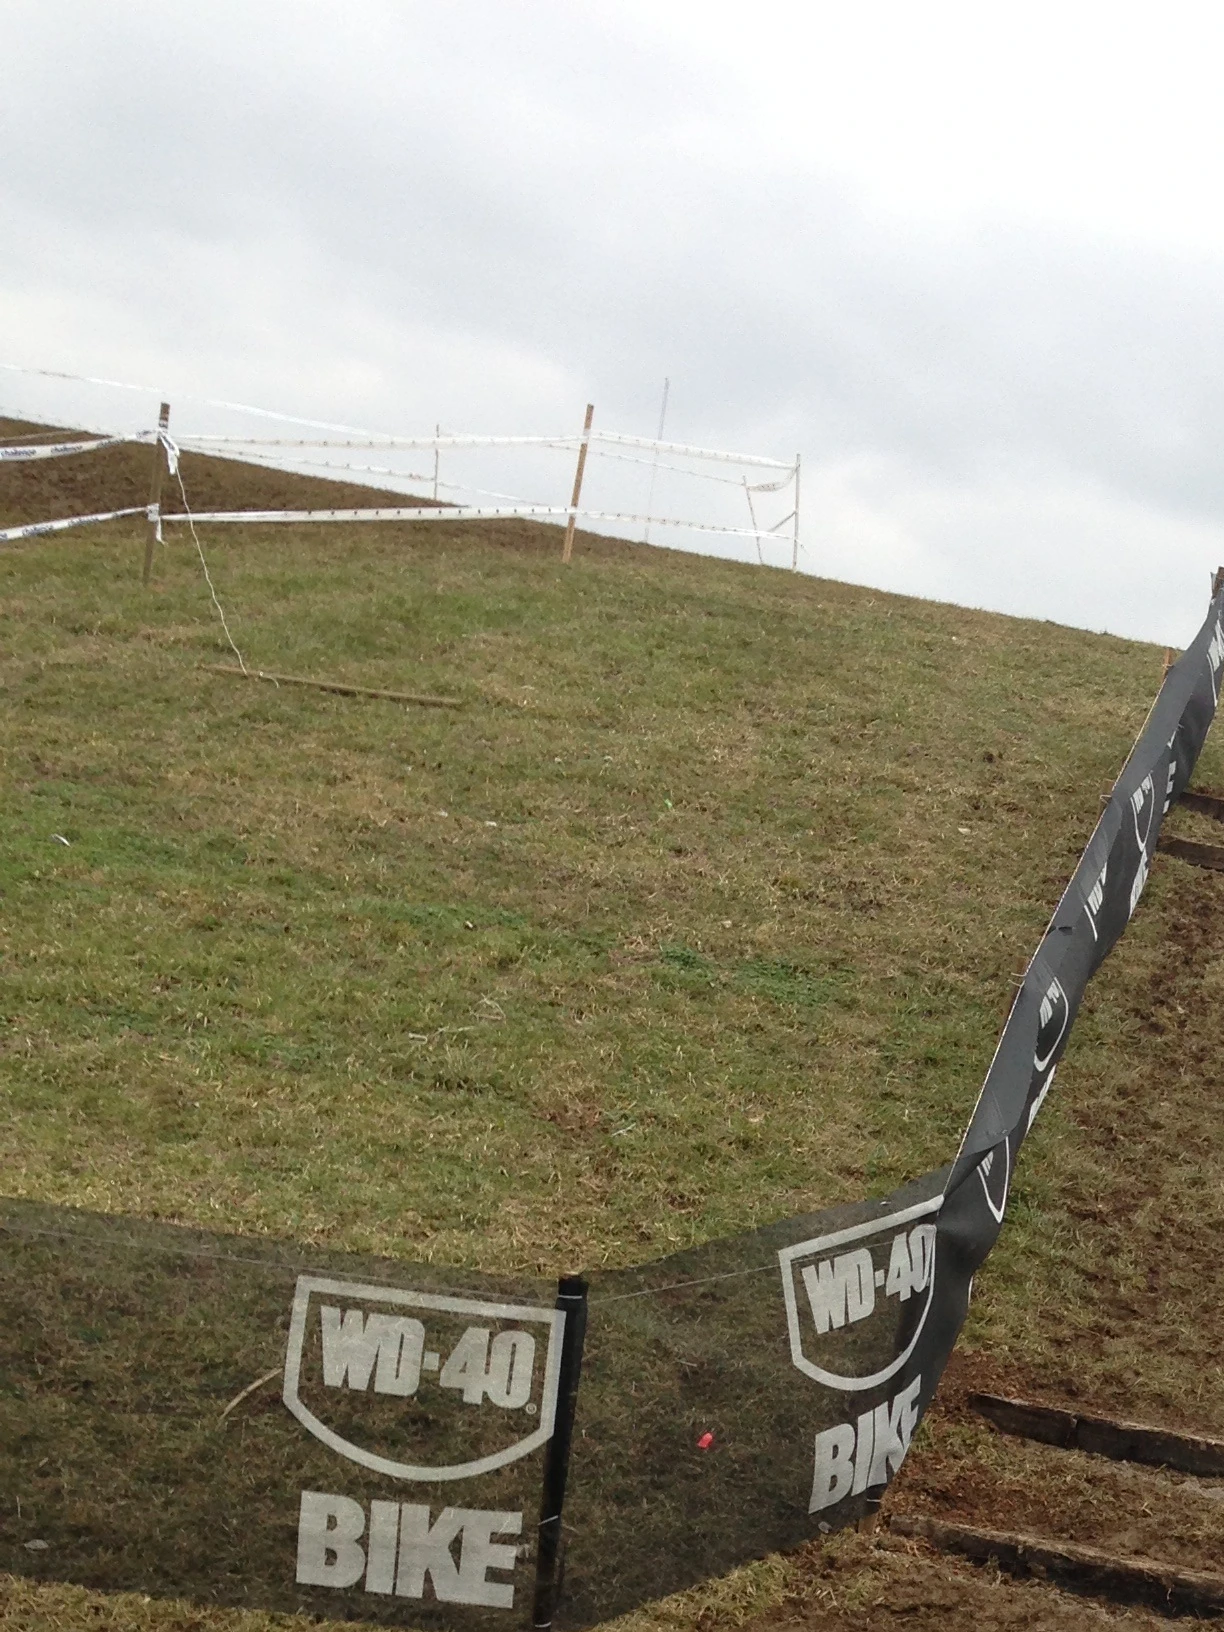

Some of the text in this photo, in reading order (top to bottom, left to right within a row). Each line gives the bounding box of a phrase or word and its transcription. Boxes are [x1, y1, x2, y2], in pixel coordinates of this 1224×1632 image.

[801, 1223, 936, 1335] WD-40
[320, 1305, 536, 1409] WD-40
[808, 1374, 922, 1515] BIKE
[295, 1490, 524, 1609] BIKE
